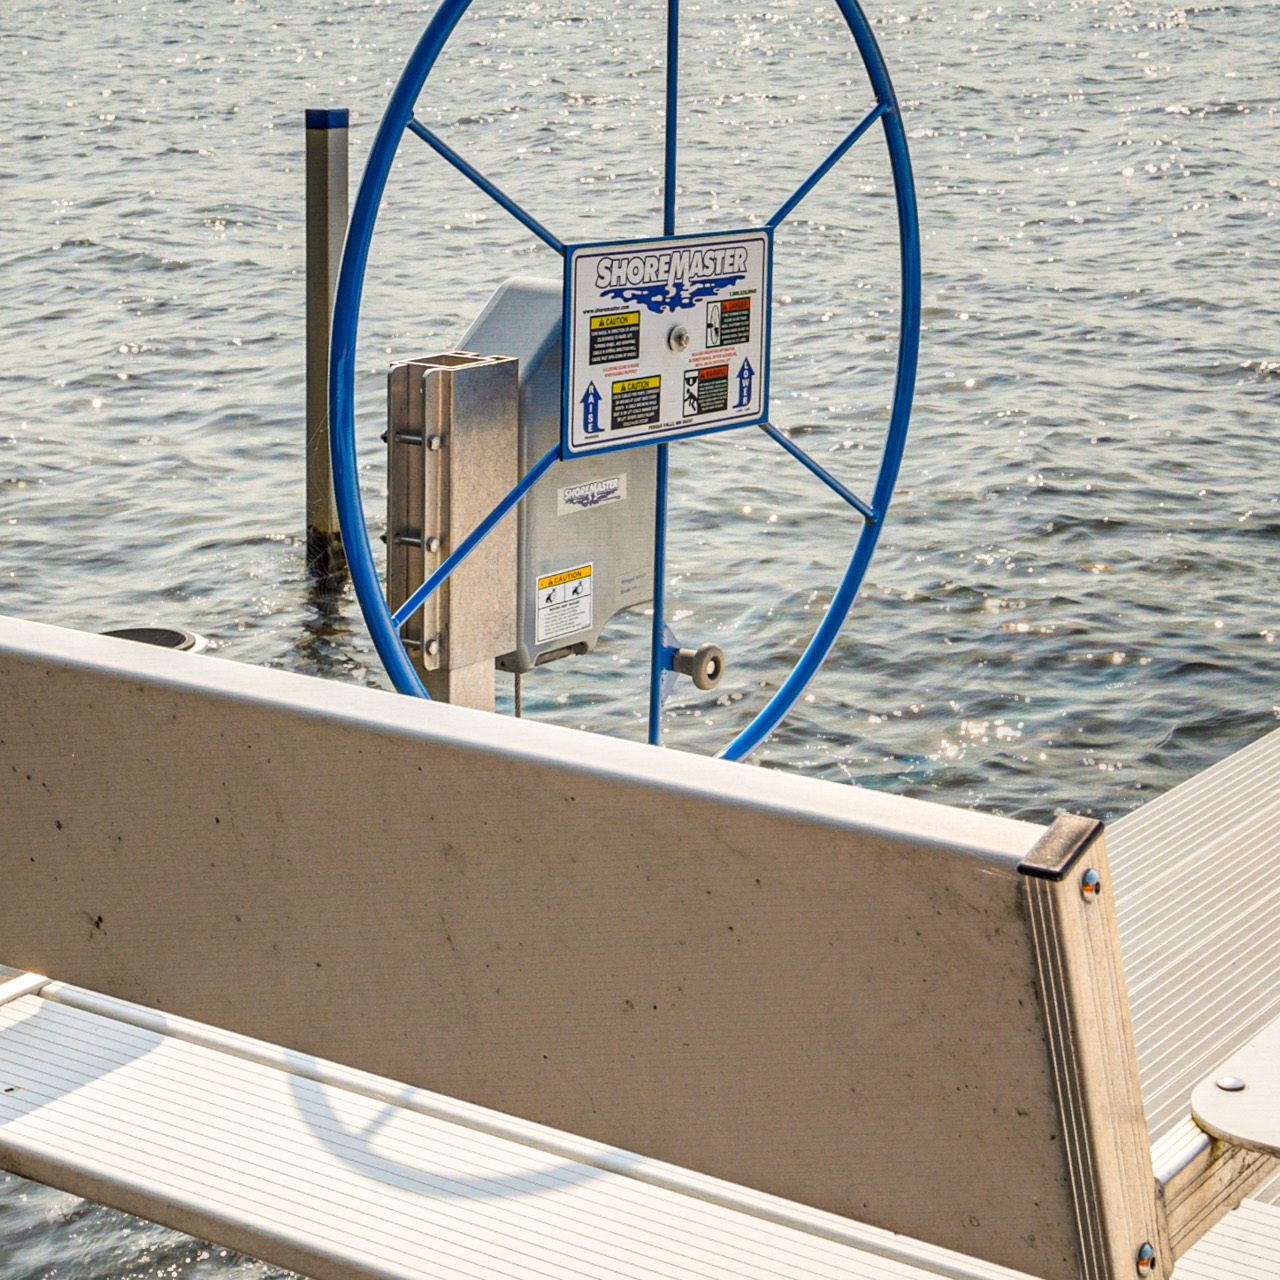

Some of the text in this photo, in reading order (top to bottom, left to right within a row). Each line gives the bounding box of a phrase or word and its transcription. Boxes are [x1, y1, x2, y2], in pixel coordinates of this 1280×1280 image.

[595, 246, 748, 289] SHOREMASTER
[605, 316, 629, 326] CAUTION
[627, 380, 650, 391] CAUTION
[742, 361, 750, 405] LOWER
[563, 477, 620, 500] SHOREMASTER
[553, 571, 582, 584] CAUTION
